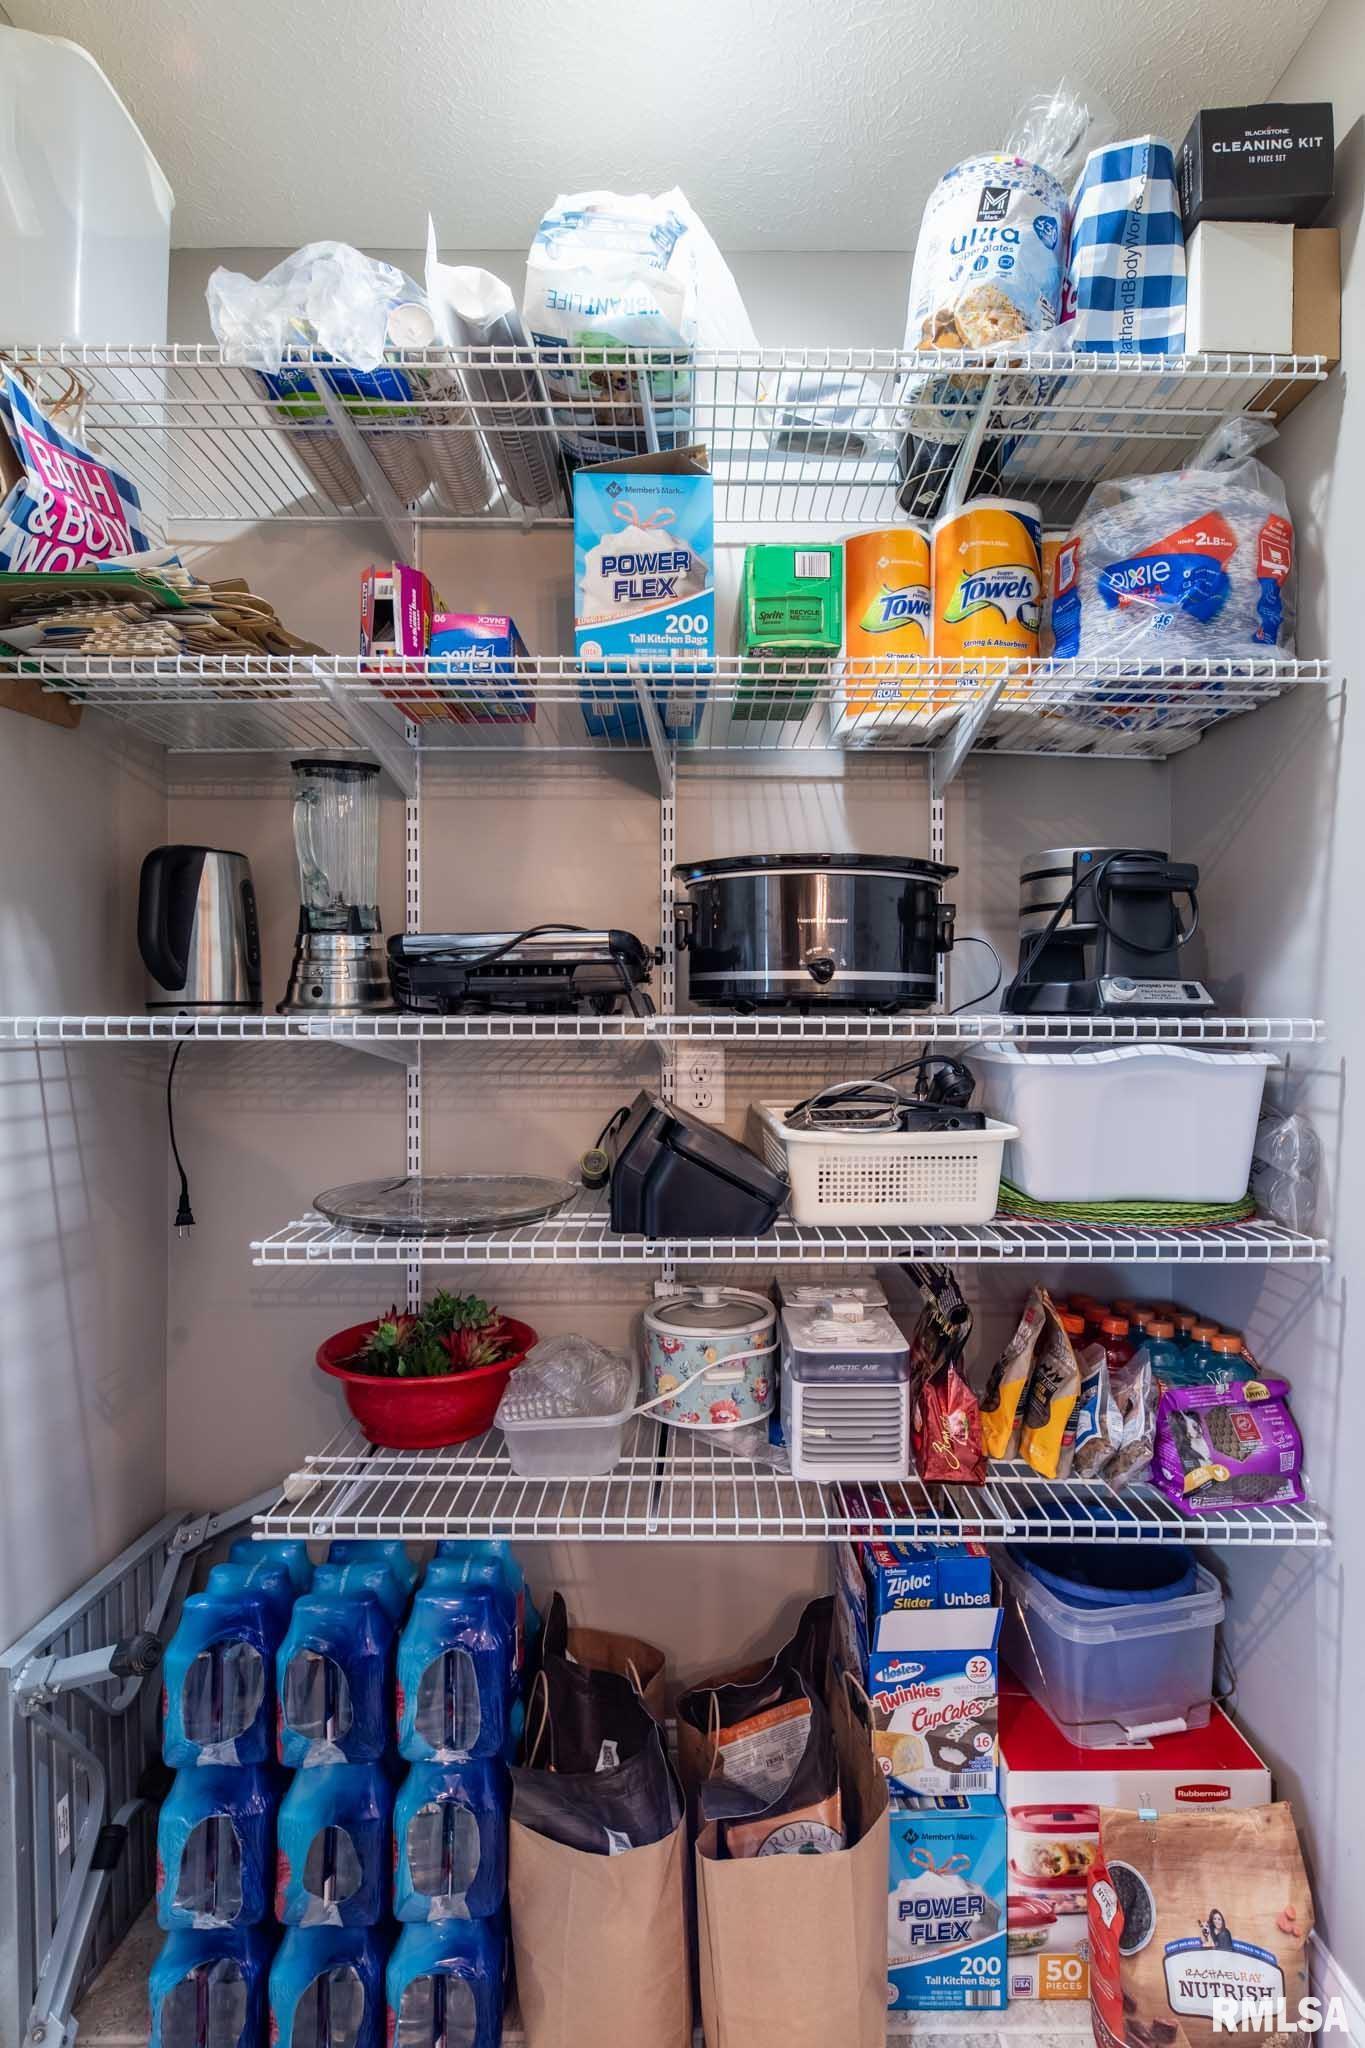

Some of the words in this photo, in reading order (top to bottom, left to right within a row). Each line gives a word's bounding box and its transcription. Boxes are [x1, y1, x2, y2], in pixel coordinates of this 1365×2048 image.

[1245, 128, 1290, 137] BLACKSTONE
[1212, 138, 1293, 153] CLEANING
[1298, 136, 1324, 148] KIT
[1257, 154, 1274, 163] PIECE
[1275, 154, 1286, 162] SET
[950, 227, 1021, 255] ultra
[982, 243, 1014, 253] plates
[30, 445, 117, 515] BATH
[624, 486, 660, 494] Member's
[27, 486, 57, 538] &
[58, 496, 136, 557] BODY
[601, 551, 692, 577] POWER
[613, 577, 678, 602] FLEX
[959, 576, 1033, 610] Towels
[434, 614, 446, 623] 90
[478, 616, 507, 626] SNACK
[665, 614, 709, 634] 200
[629, 634, 646, 644] Tall
[647, 634, 684, 644] Kitchen
[684, 635, 709, 645] Bags
[963, 639, 986, 649] Strong
[986, 639, 993, 647] &
[887, 1574, 931, 1598] Ziploc
[893, 1597, 935, 1609] Slider
[881, 1662, 923, 1683] Hostess
[970, 1660, 987, 1673] 32
[874, 1684, 942, 1714] Twinkies
[911, 1699, 984, 1733] CupCakes
[975, 1736, 990, 1748] 16
[1177, 1789, 1229, 1799] Rubbermaid
[921, 1832, 955, 1841] Member's
[898, 1895, 985, 1920] POWER
[910, 1920, 972, 1945] FLEX
[960, 1956, 1002, 1976] 200
[1046, 1959, 1083, 1981] 50
[925, 1976, 942, 1985] Tall
[942, 1976, 978, 1985] Kitchen
[978, 1976, 1001, 1987] Bags
[1014, 1980, 1030, 1988] USA
[1046, 1981, 1082, 1990] PIECES
[1178, 1979, 1274, 2002] NUTRISH
